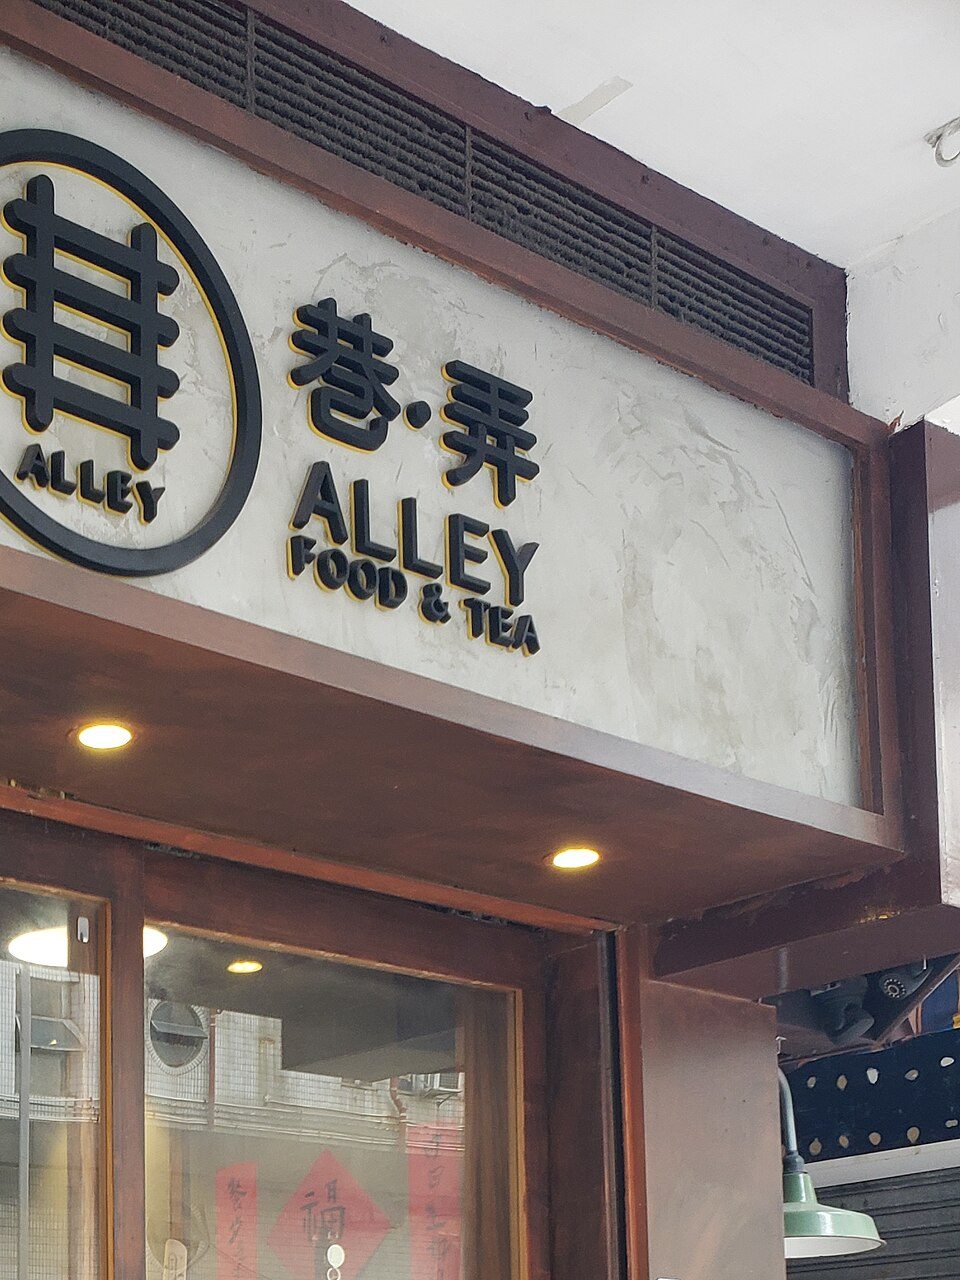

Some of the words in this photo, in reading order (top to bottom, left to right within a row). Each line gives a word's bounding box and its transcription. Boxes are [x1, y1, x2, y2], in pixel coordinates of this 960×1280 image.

[14, 443, 166, 525] ALLEY
[291, 461, 540, 607] ALLEY
[287, 535, 409, 610] FOOD
[418, 583, 452, 625] &
[462, 596, 542, 656] TEA
